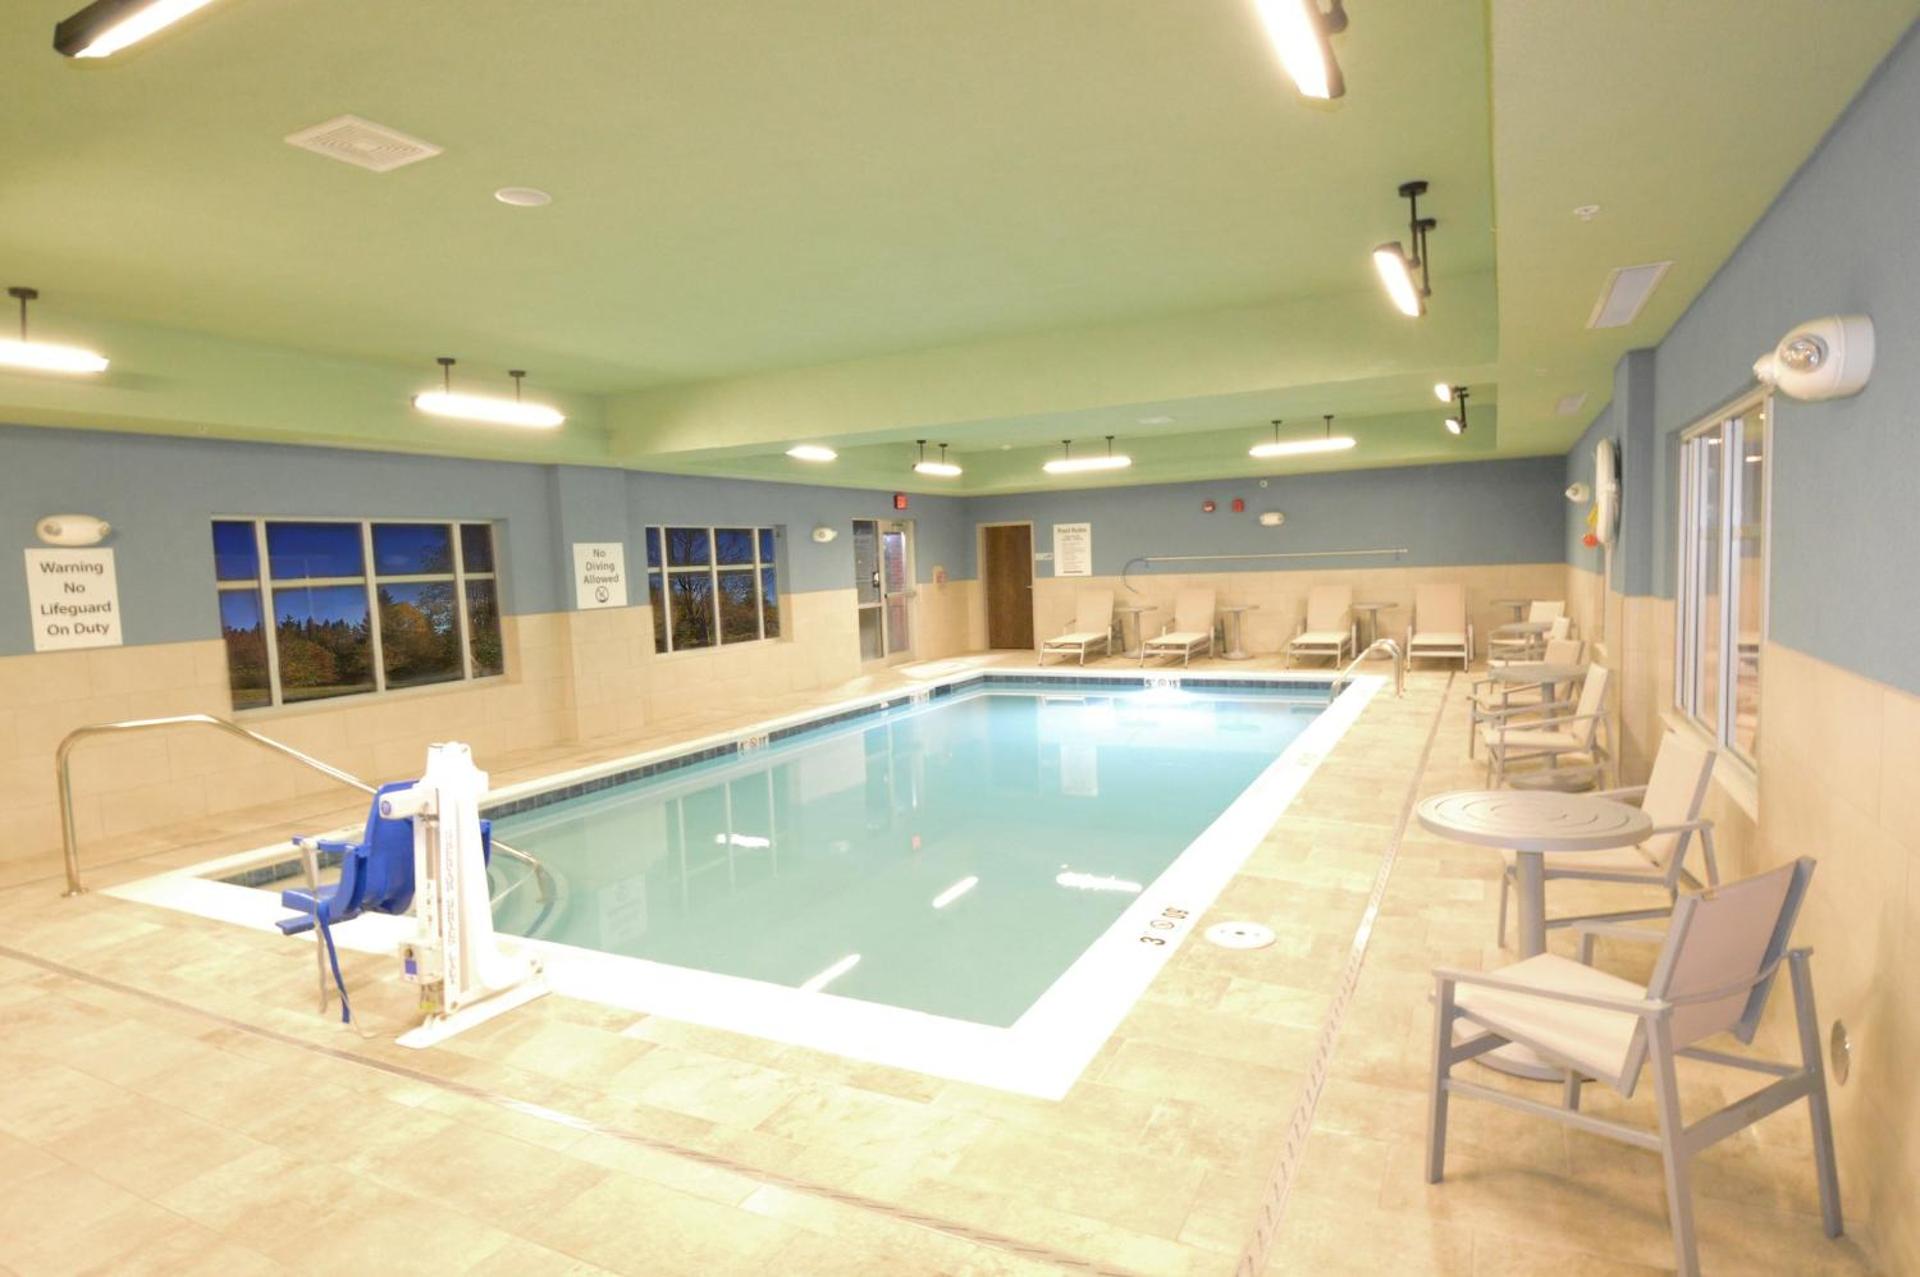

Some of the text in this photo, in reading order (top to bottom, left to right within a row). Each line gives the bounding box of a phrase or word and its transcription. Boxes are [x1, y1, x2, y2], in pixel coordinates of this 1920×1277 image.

[592, 549, 607, 558] No
[40, 561, 104, 575] Warning
[585, 561, 616, 573] Diving
[63, 582, 86, 594] No
[40, 601, 112, 616] Lifeguard
[47, 622, 110, 636] On Duty
